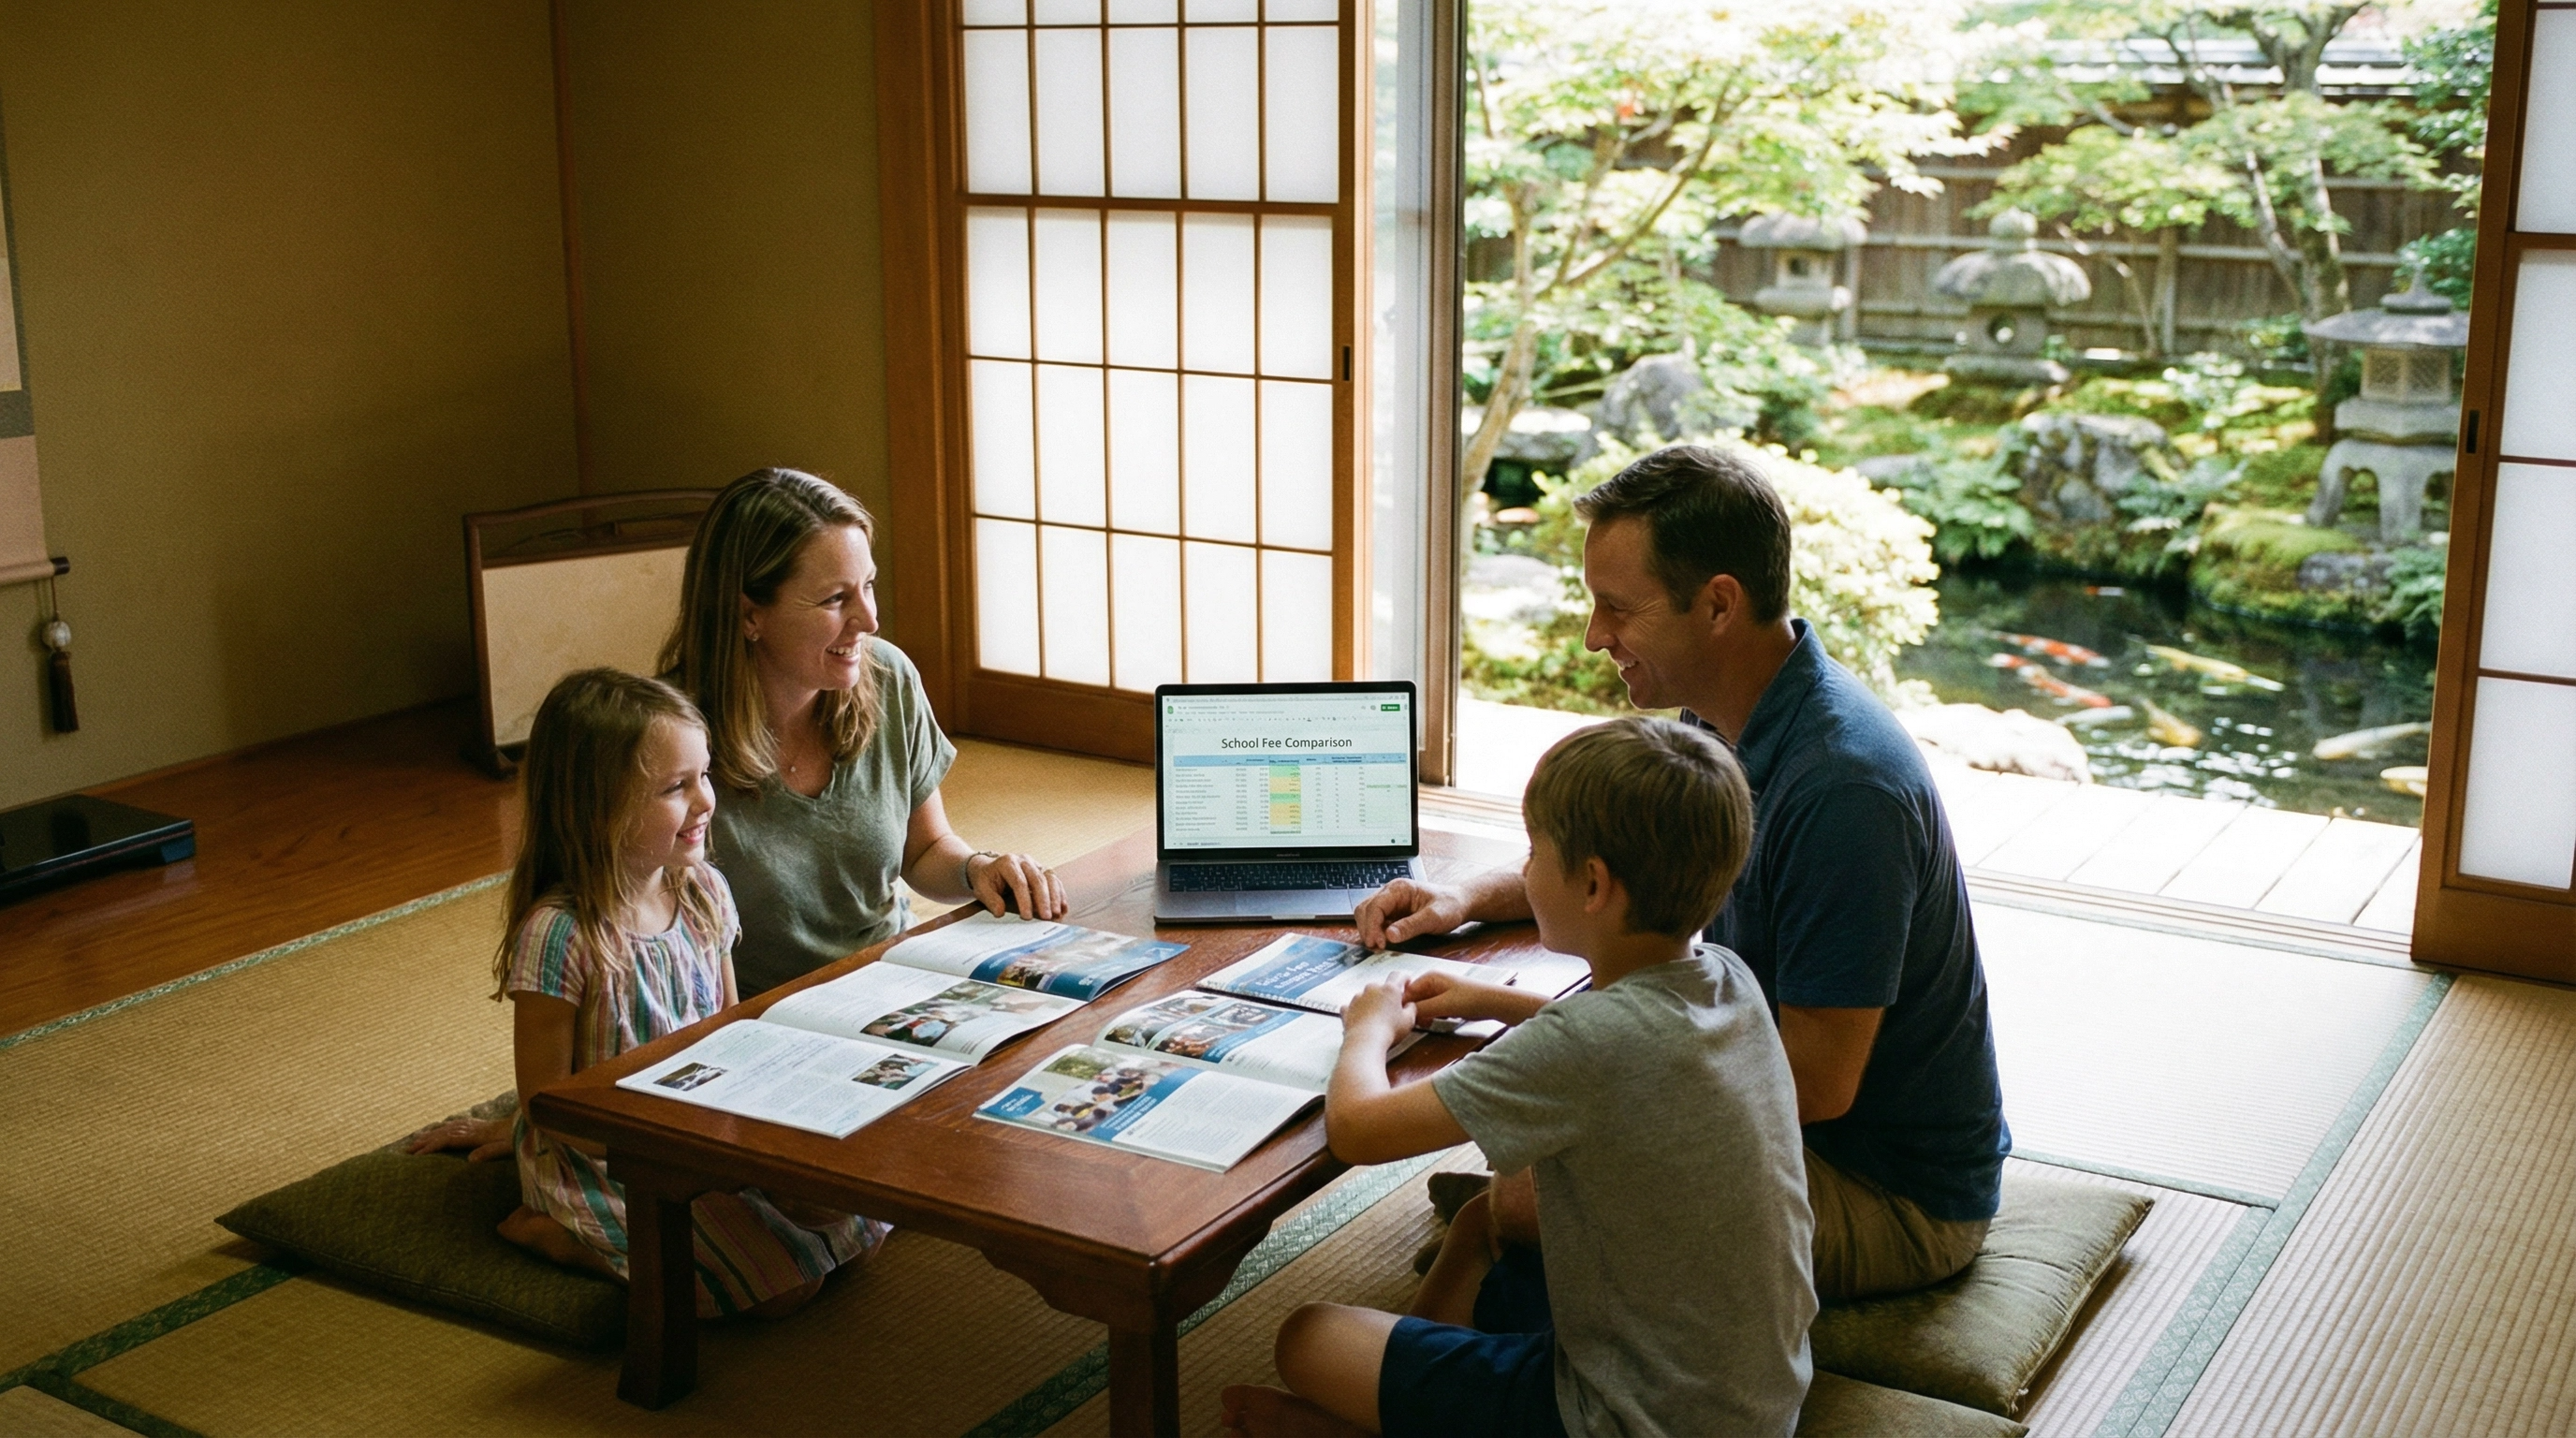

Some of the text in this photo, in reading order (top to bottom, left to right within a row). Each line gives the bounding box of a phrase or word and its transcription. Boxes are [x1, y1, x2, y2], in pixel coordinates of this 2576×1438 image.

[1221, 737, 1353, 750] School Fee Comparison
